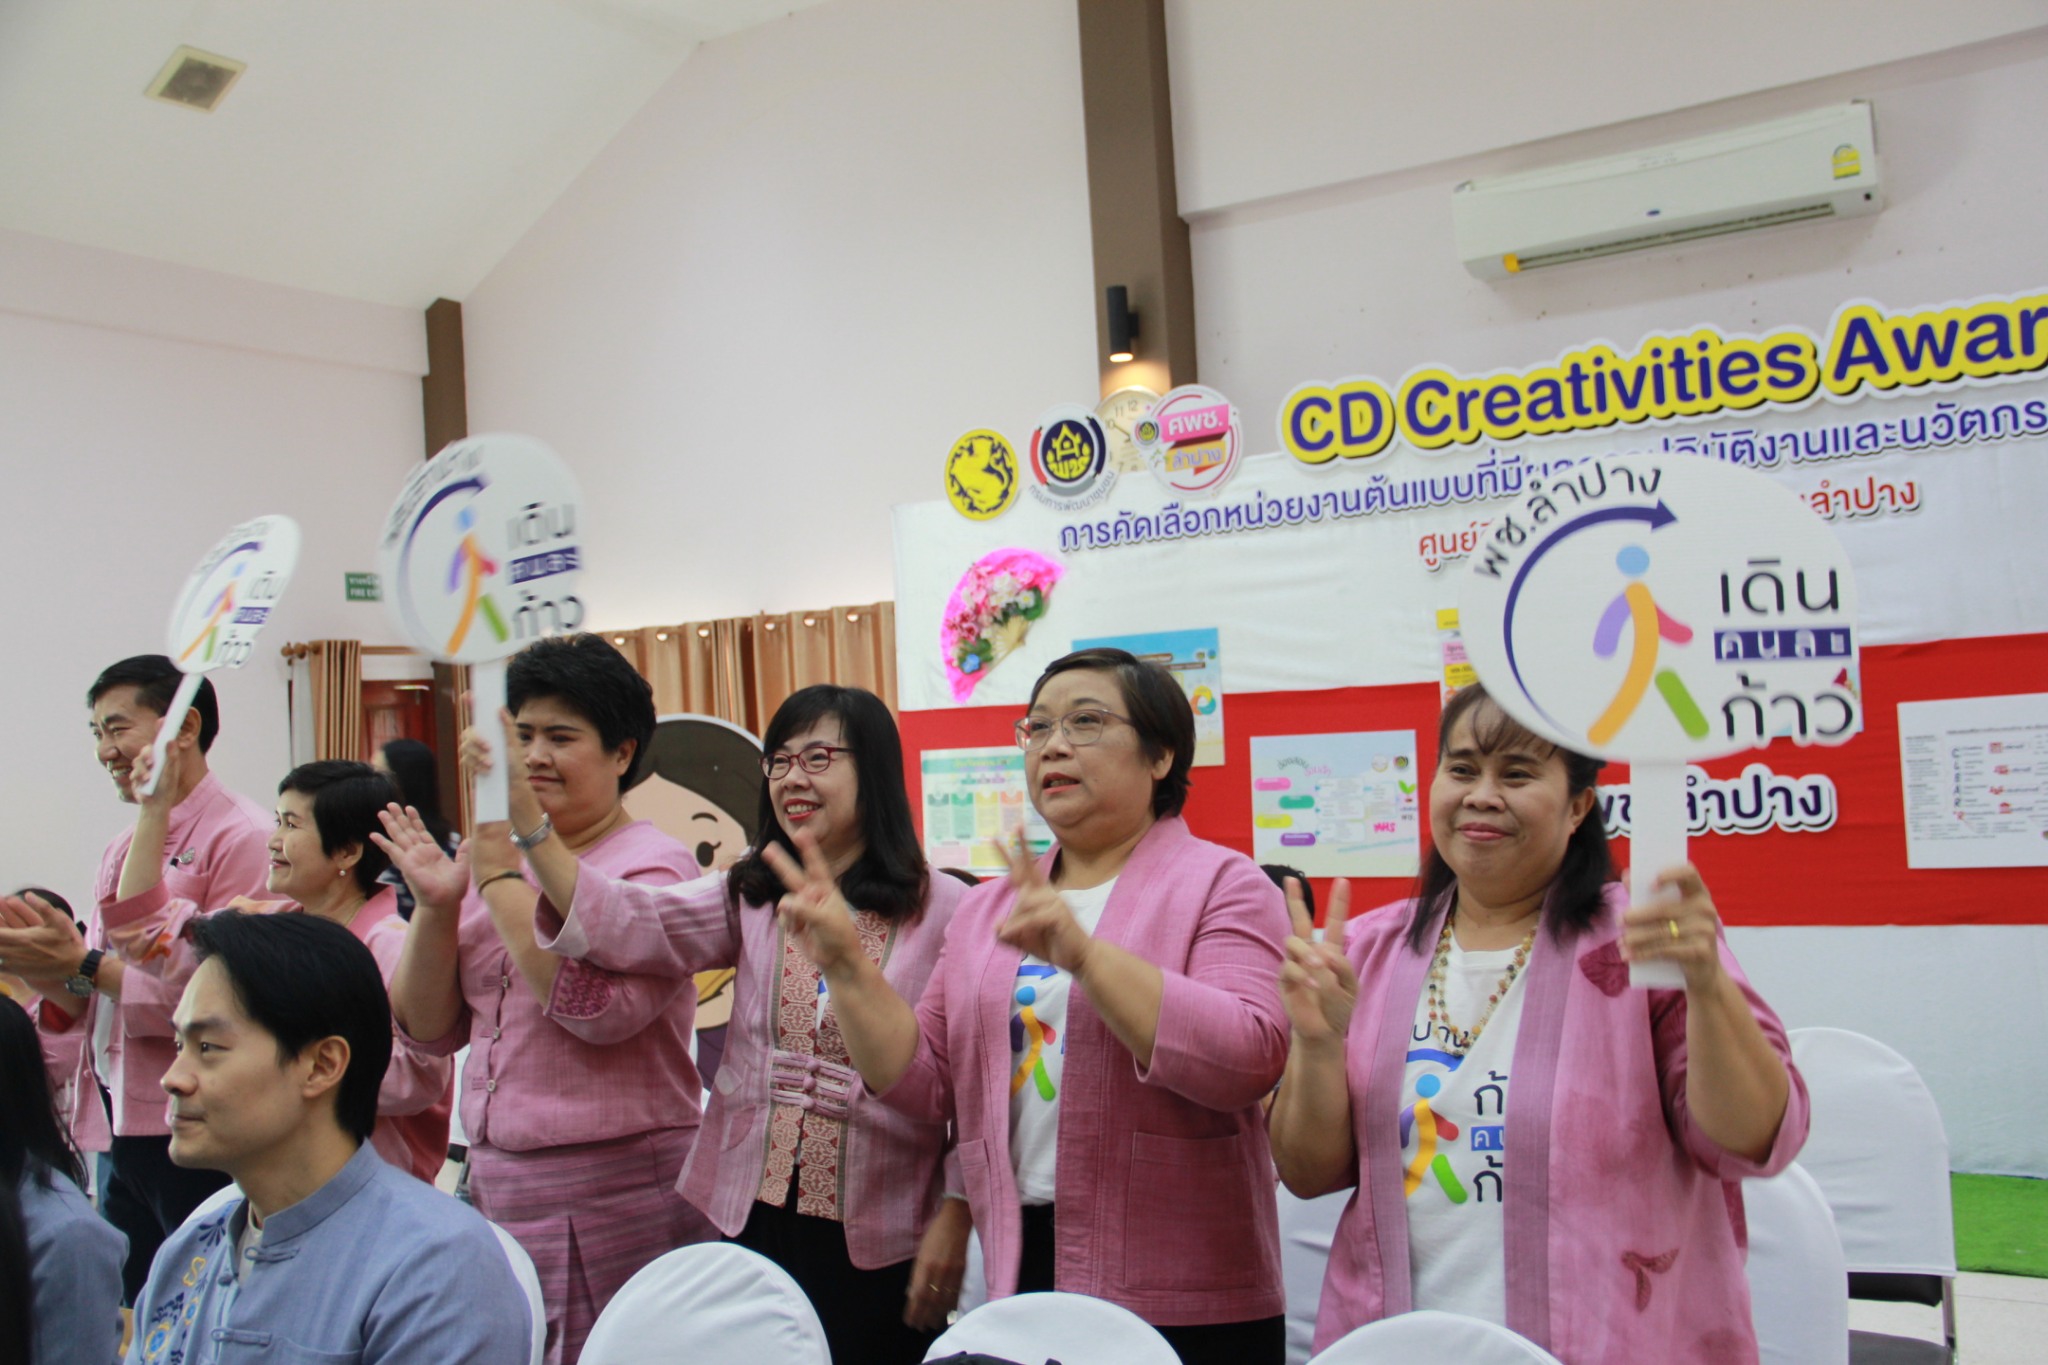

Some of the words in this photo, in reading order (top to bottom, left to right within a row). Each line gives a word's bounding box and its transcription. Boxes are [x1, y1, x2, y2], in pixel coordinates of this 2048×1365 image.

[1168, 411, 1224, 437] ศพช.
[1290, 390, 1384, 452] CD
[1405, 340, 1805, 437] Creativities
[1719, 557, 1840, 616] เดิน
[1721, 630, 1847, 660] คนละ
[1720, 672, 1855, 740] ก้าว
